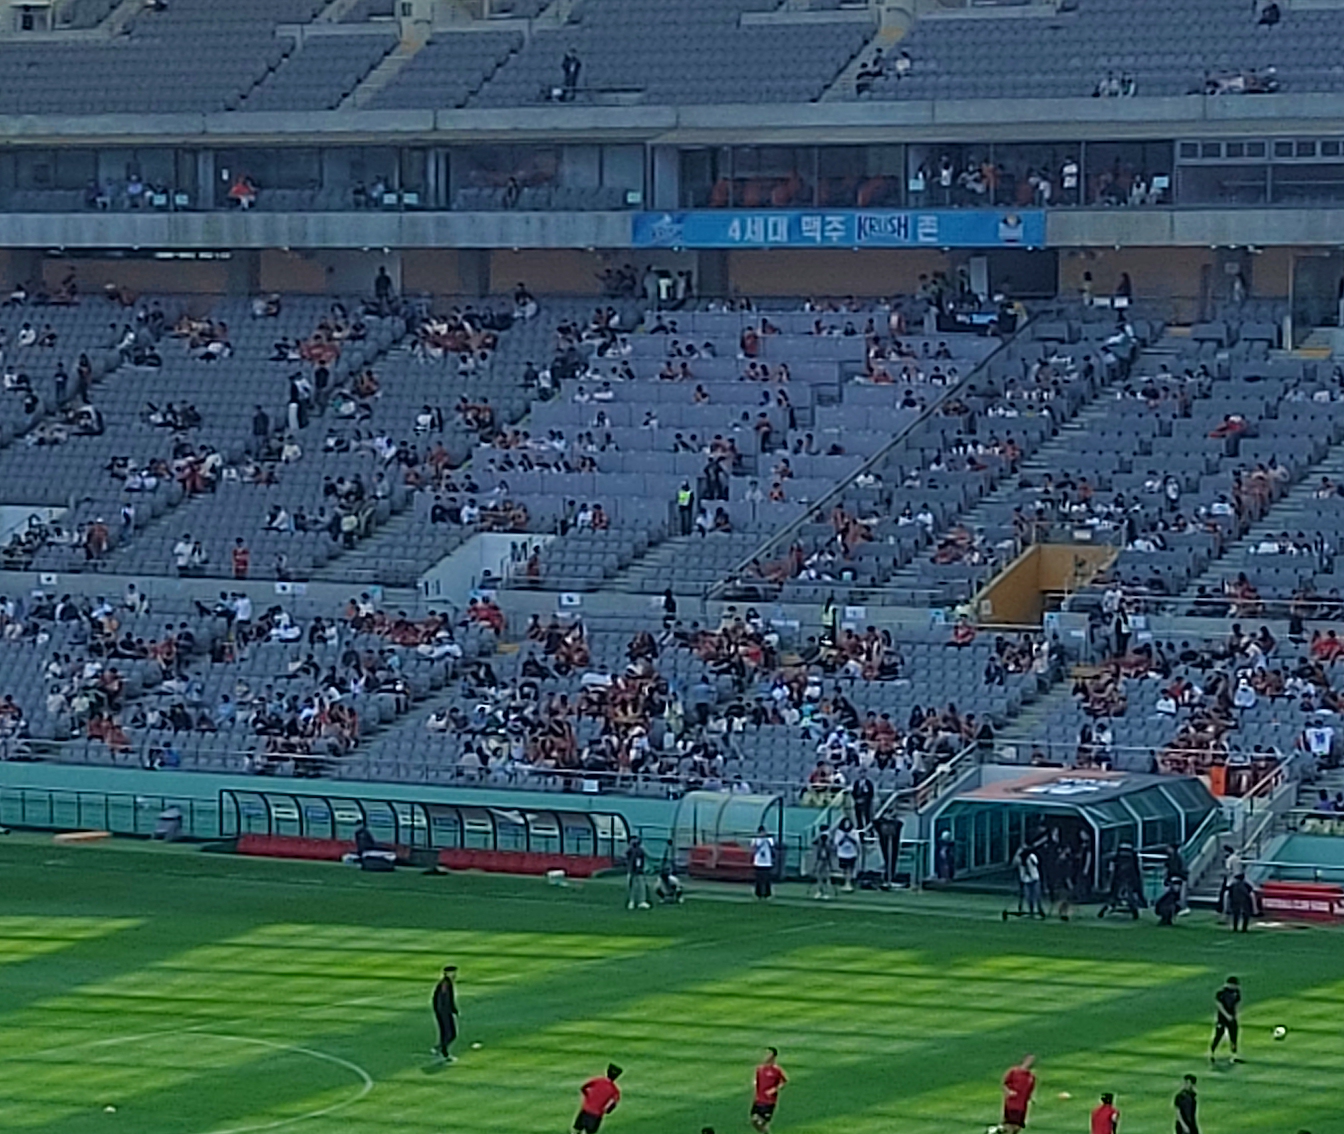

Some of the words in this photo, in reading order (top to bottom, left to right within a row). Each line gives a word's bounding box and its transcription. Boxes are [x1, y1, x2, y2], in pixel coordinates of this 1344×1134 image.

[728, 216, 788, 242] 4세대
[801, 215, 846, 242] 맥주
[857, 214, 908, 241] KRUSH
